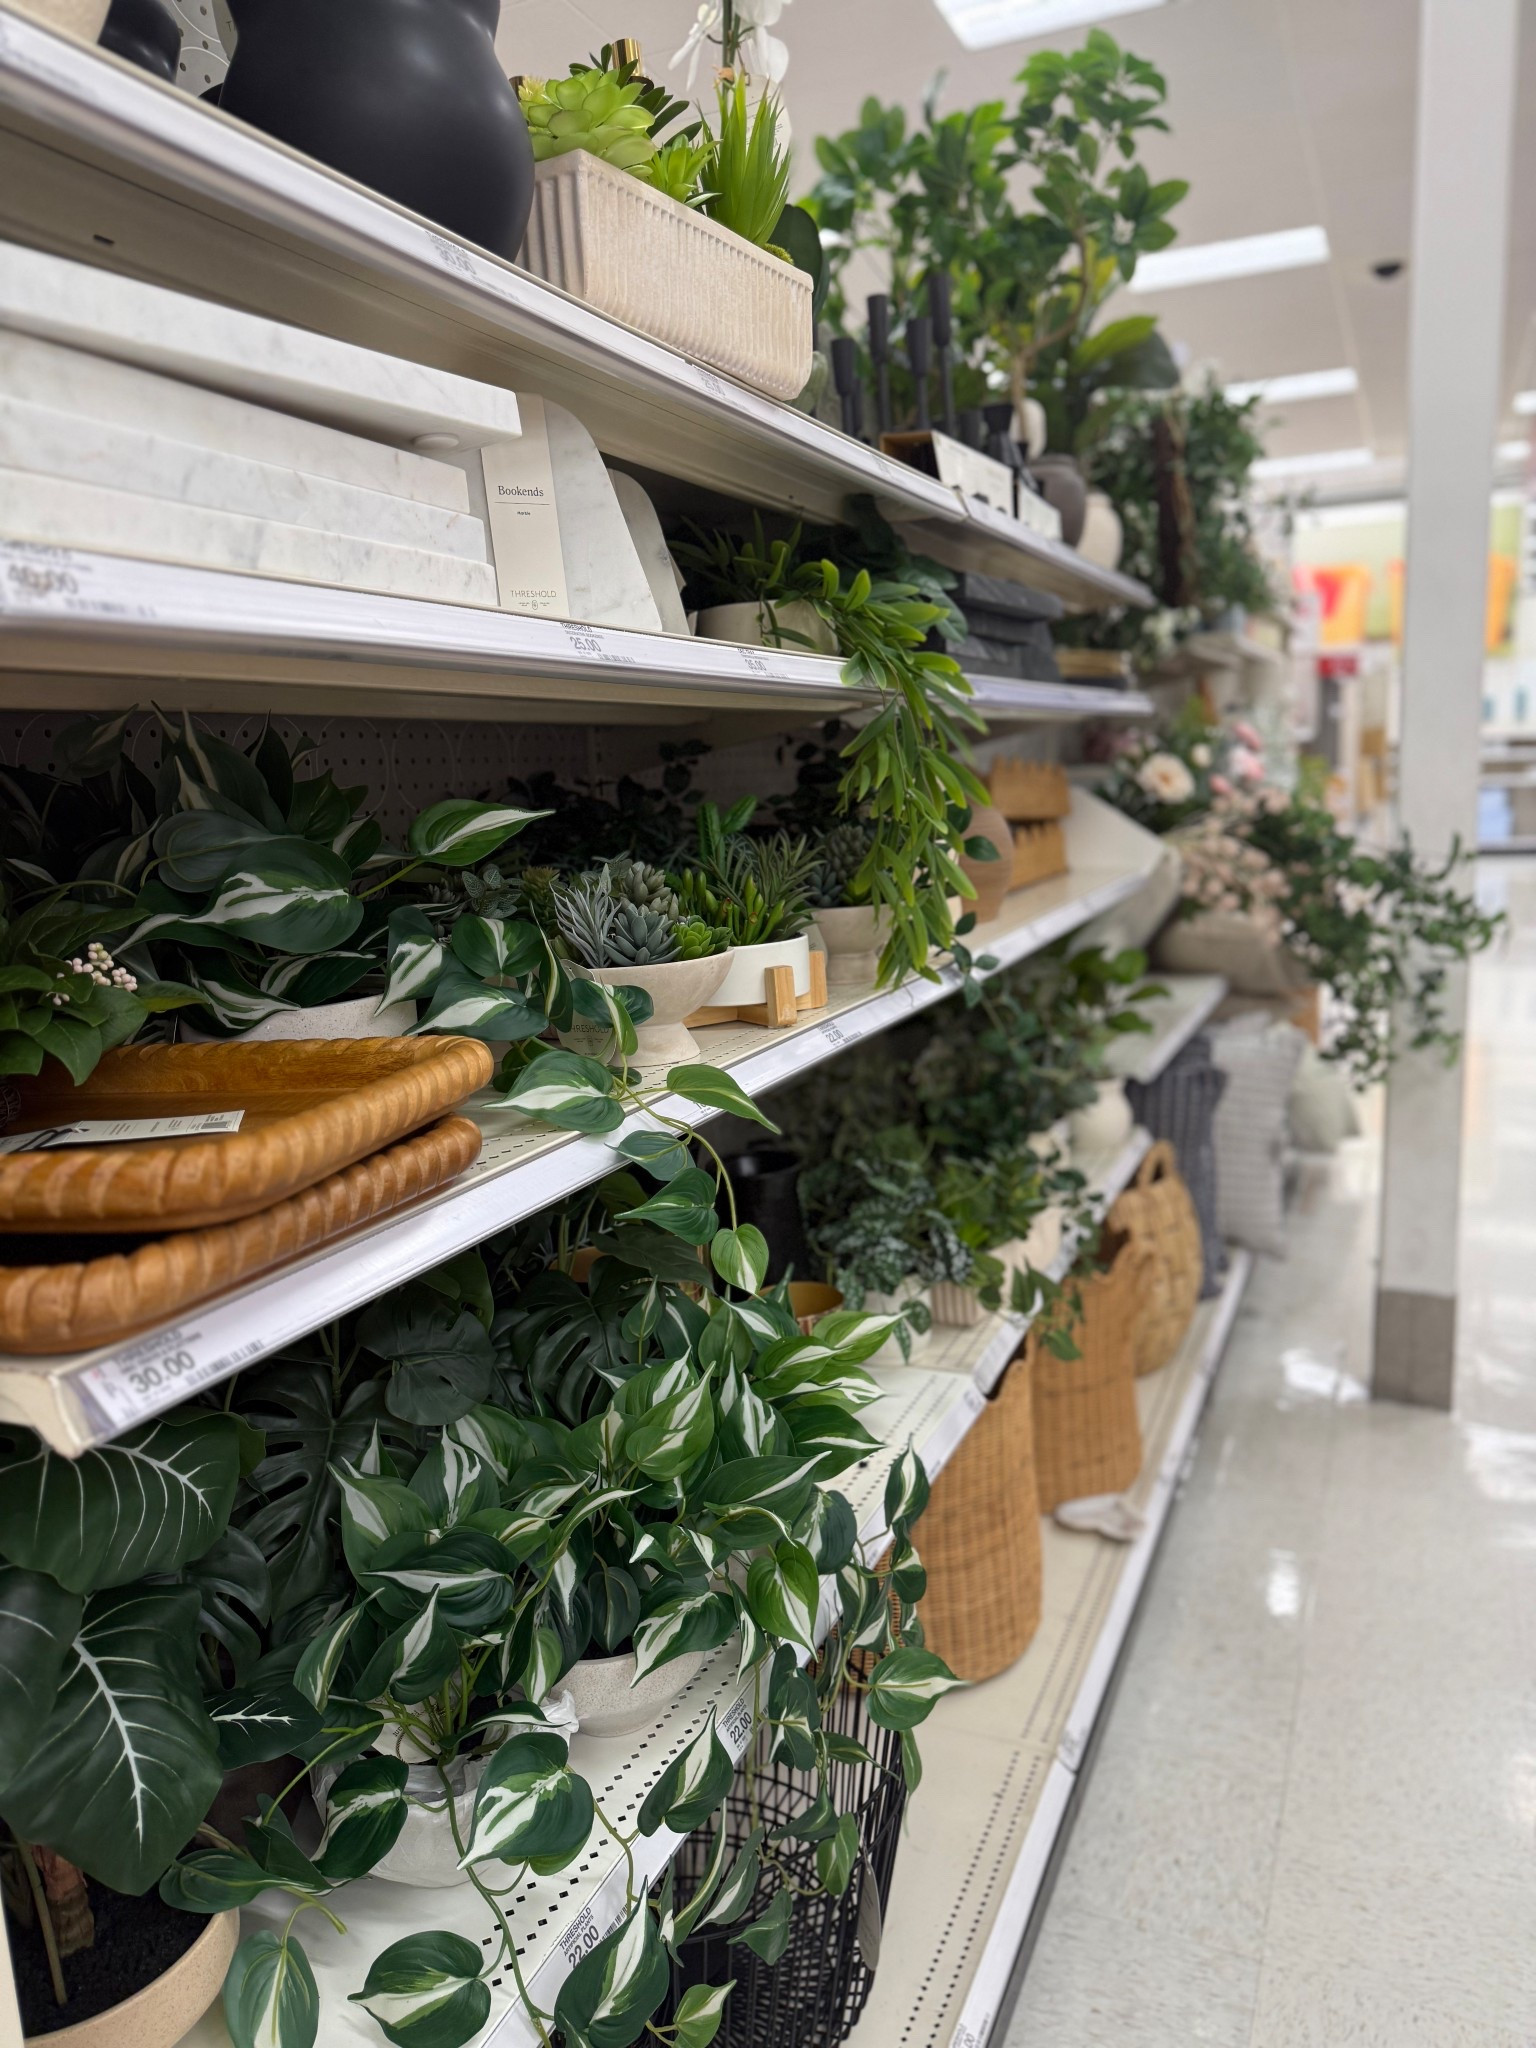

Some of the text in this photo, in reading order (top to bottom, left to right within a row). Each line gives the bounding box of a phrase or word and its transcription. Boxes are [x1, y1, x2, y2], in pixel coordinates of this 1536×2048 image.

[498, 485, 544, 497] Bookends
[511, 590, 557, 598] THRESHOLD
[569, 636, 602, 652] 25.00
[128, 1350, 196, 1394] 30.00
[722, 1698, 745, 1728] THRESHOLD
[730, 1711, 752, 1745] 22.00
[560, 1906, 592, 1951] THRESHOLD
[563, 1914, 595, 1957] ARTIFICIAL PLANTS
[568, 1925, 600, 1969] 22.00
